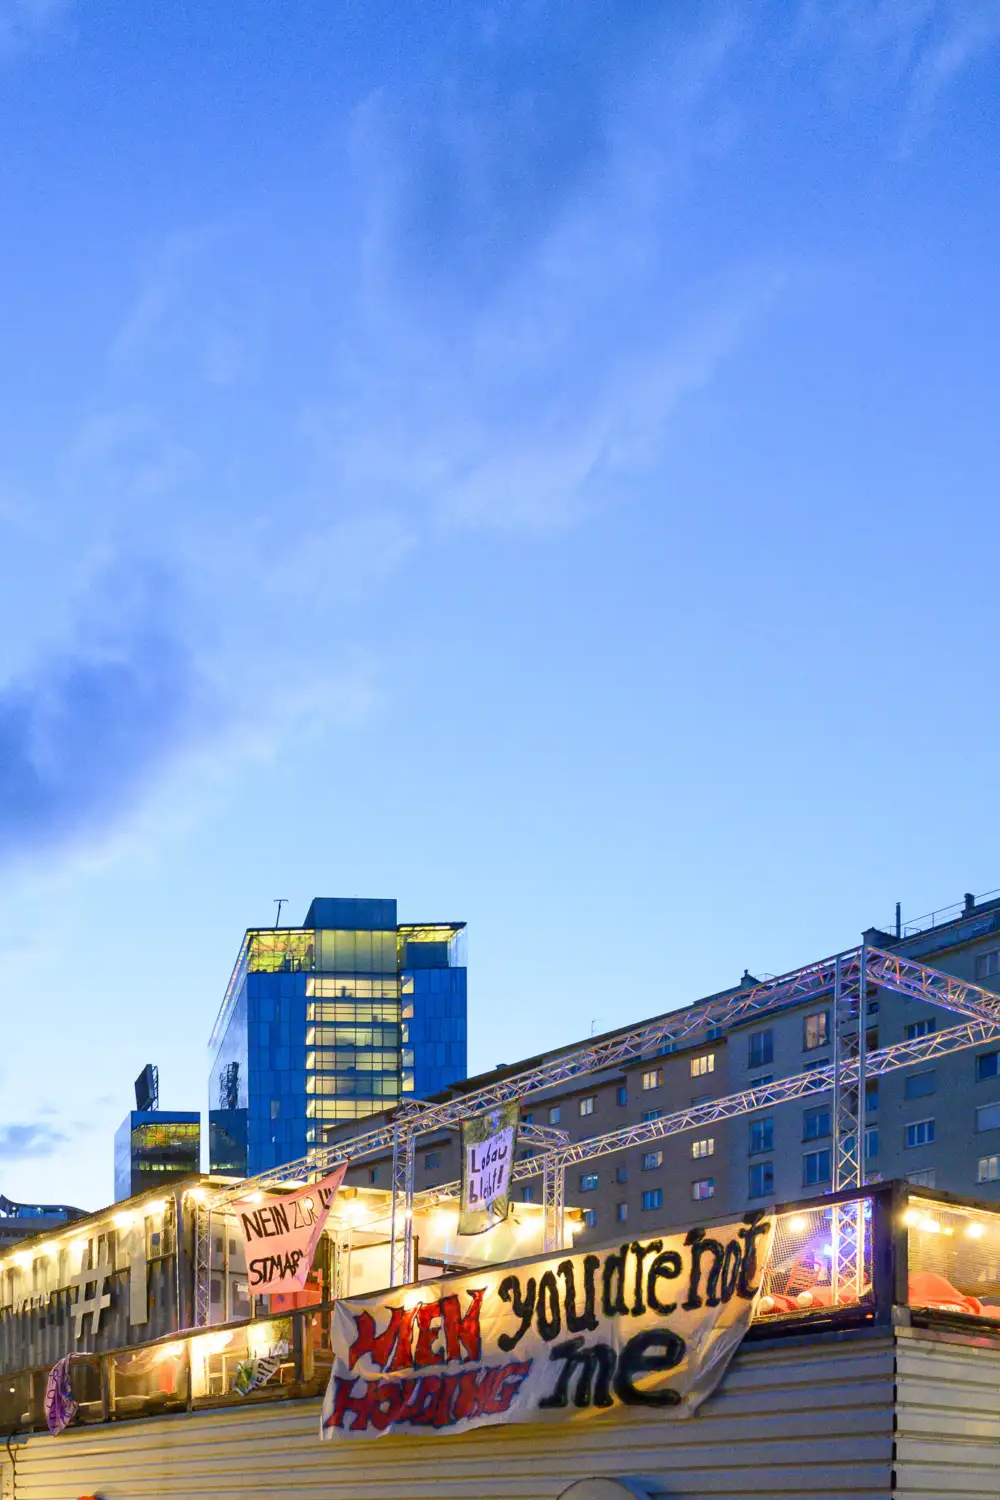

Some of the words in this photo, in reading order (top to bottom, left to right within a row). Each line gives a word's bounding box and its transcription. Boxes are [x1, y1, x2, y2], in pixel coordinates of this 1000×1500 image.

[471, 1144, 508, 1173] Lobau
[241, 1203, 290, 1242] NEIN
[289, 1196, 319, 1230] ZUR
[682, 1209, 772, 1310] not
[348, 1286, 489, 1372] WIEN
[538, 1325, 687, 1409] me
[325, 1358, 534, 1431] HOLDING
